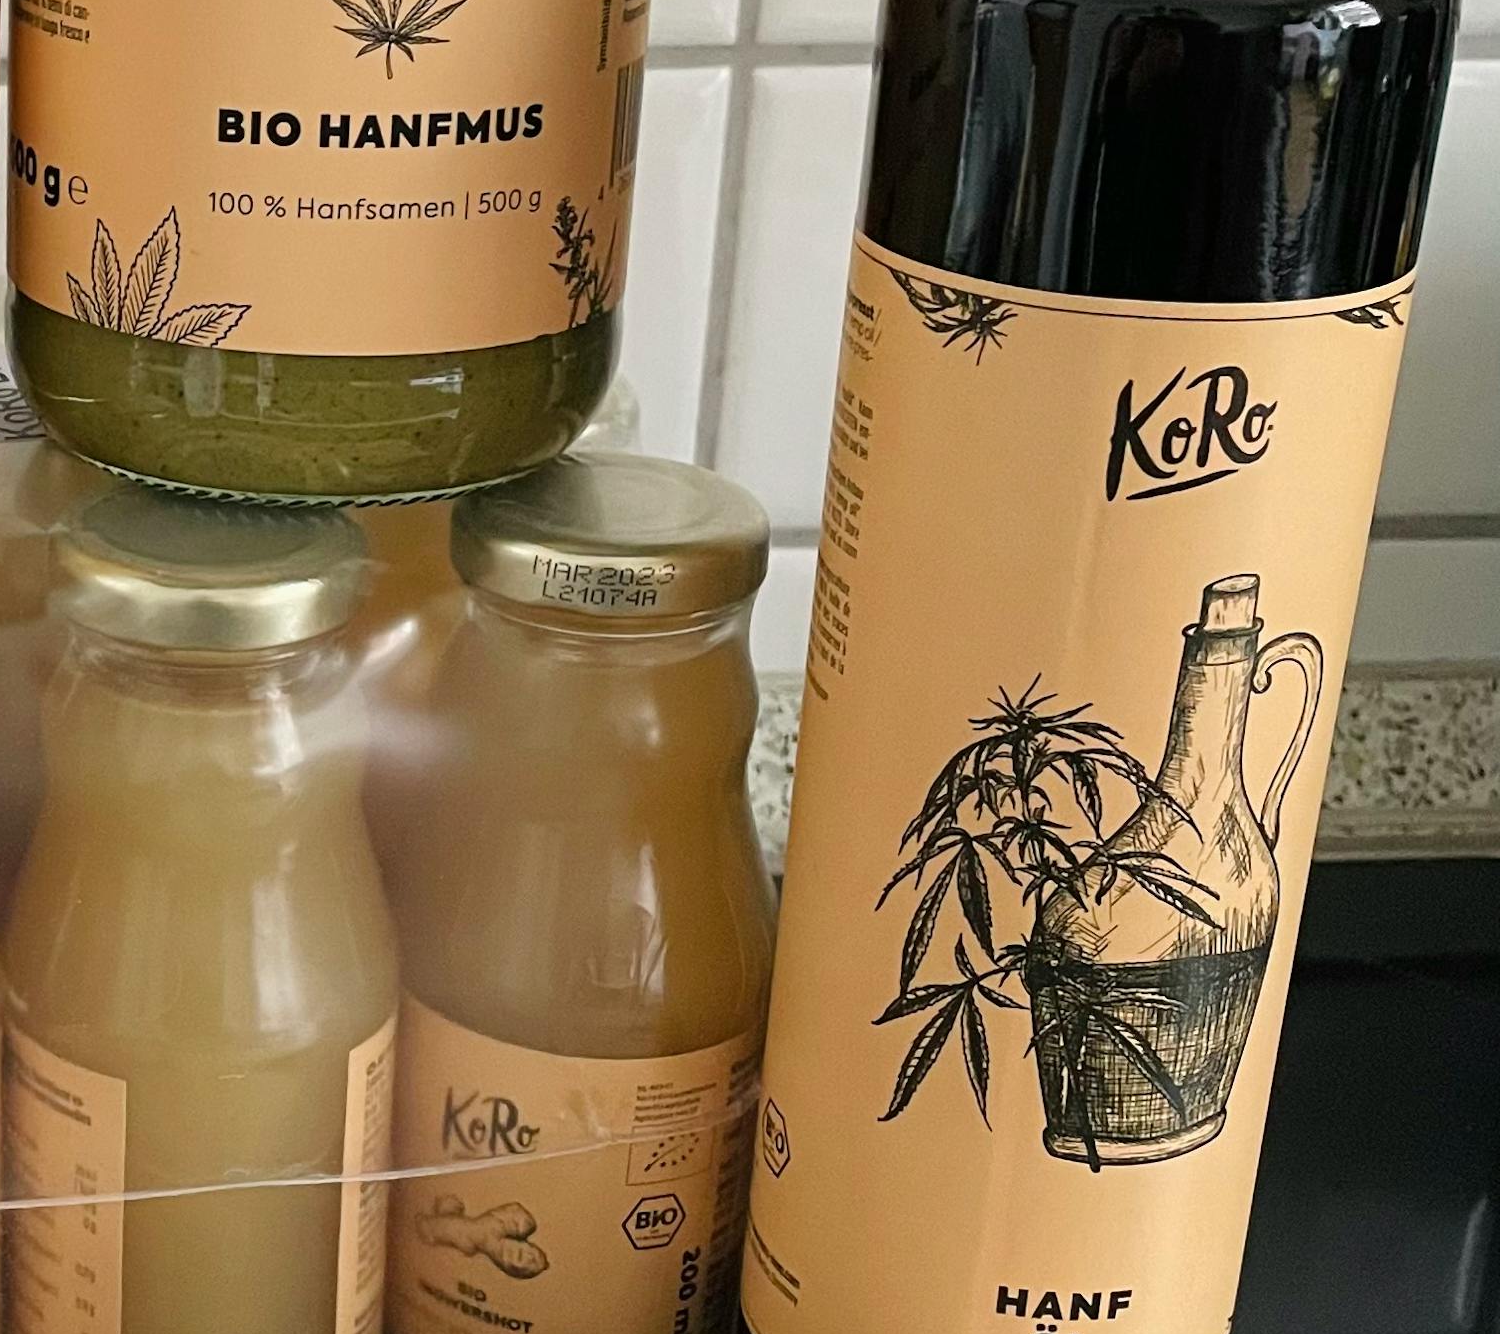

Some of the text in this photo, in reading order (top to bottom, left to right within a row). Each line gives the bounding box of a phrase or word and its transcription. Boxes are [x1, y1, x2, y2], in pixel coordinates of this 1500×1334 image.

[218, 104, 543, 148] BIO HANFMUS
[13, 139, 38, 187] 00
[44, 164, 60, 208] g
[208, 189, 541, 220] 100 % Hanfsamen 500 g
[1106, 366, 1277, 501] KoRo
[532, 554, 678, 588] MAR 2023
[542, 580, 658, 608] L21074A
[441, 1086, 541, 1162] KoRo
[635, 1207, 679, 1230] BIO
[679, 1246, 702, 1303] 200
[996, 1284, 1132, 1323] HANF
